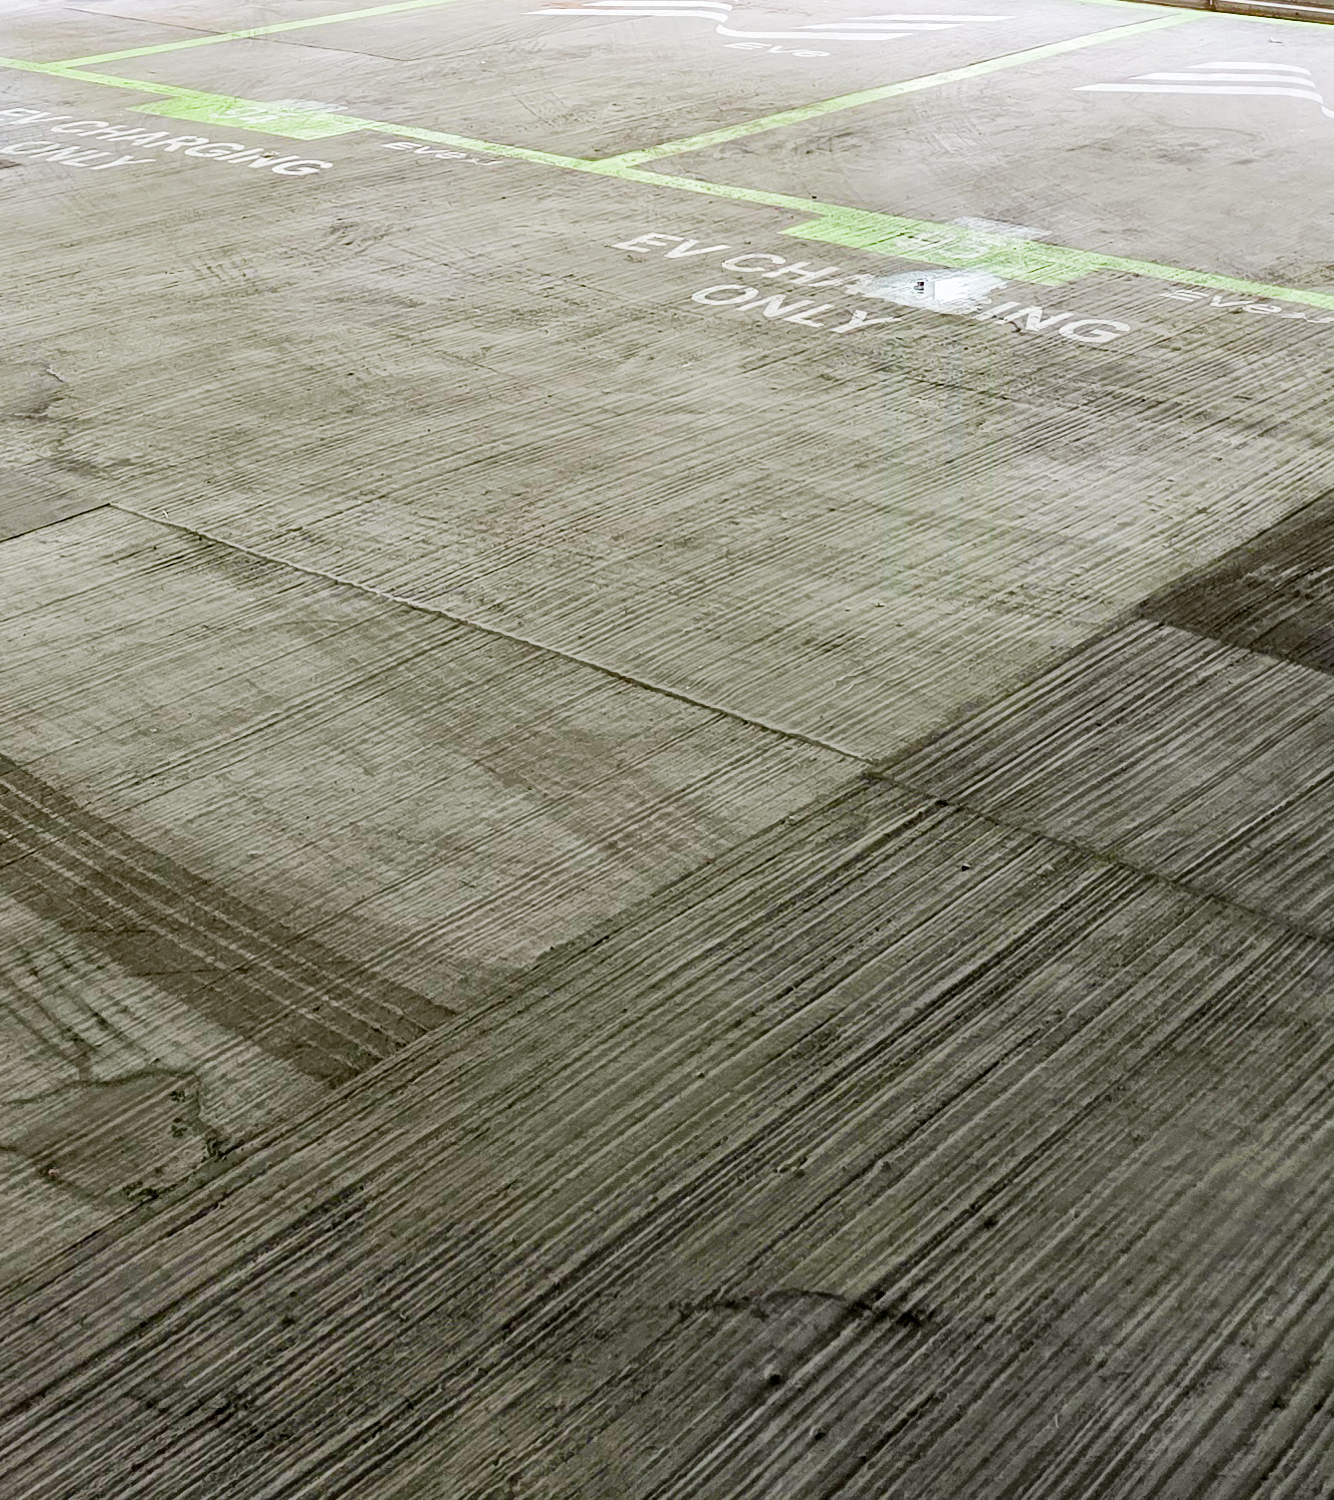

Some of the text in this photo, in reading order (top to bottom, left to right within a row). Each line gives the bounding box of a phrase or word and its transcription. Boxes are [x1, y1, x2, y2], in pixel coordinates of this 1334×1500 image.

[0, 140, 158, 171] ONLY
[51, 120, 334, 176] CHARGING
[612, 232, 731, 260] EV
[690, 284, 901, 334] ONLY
